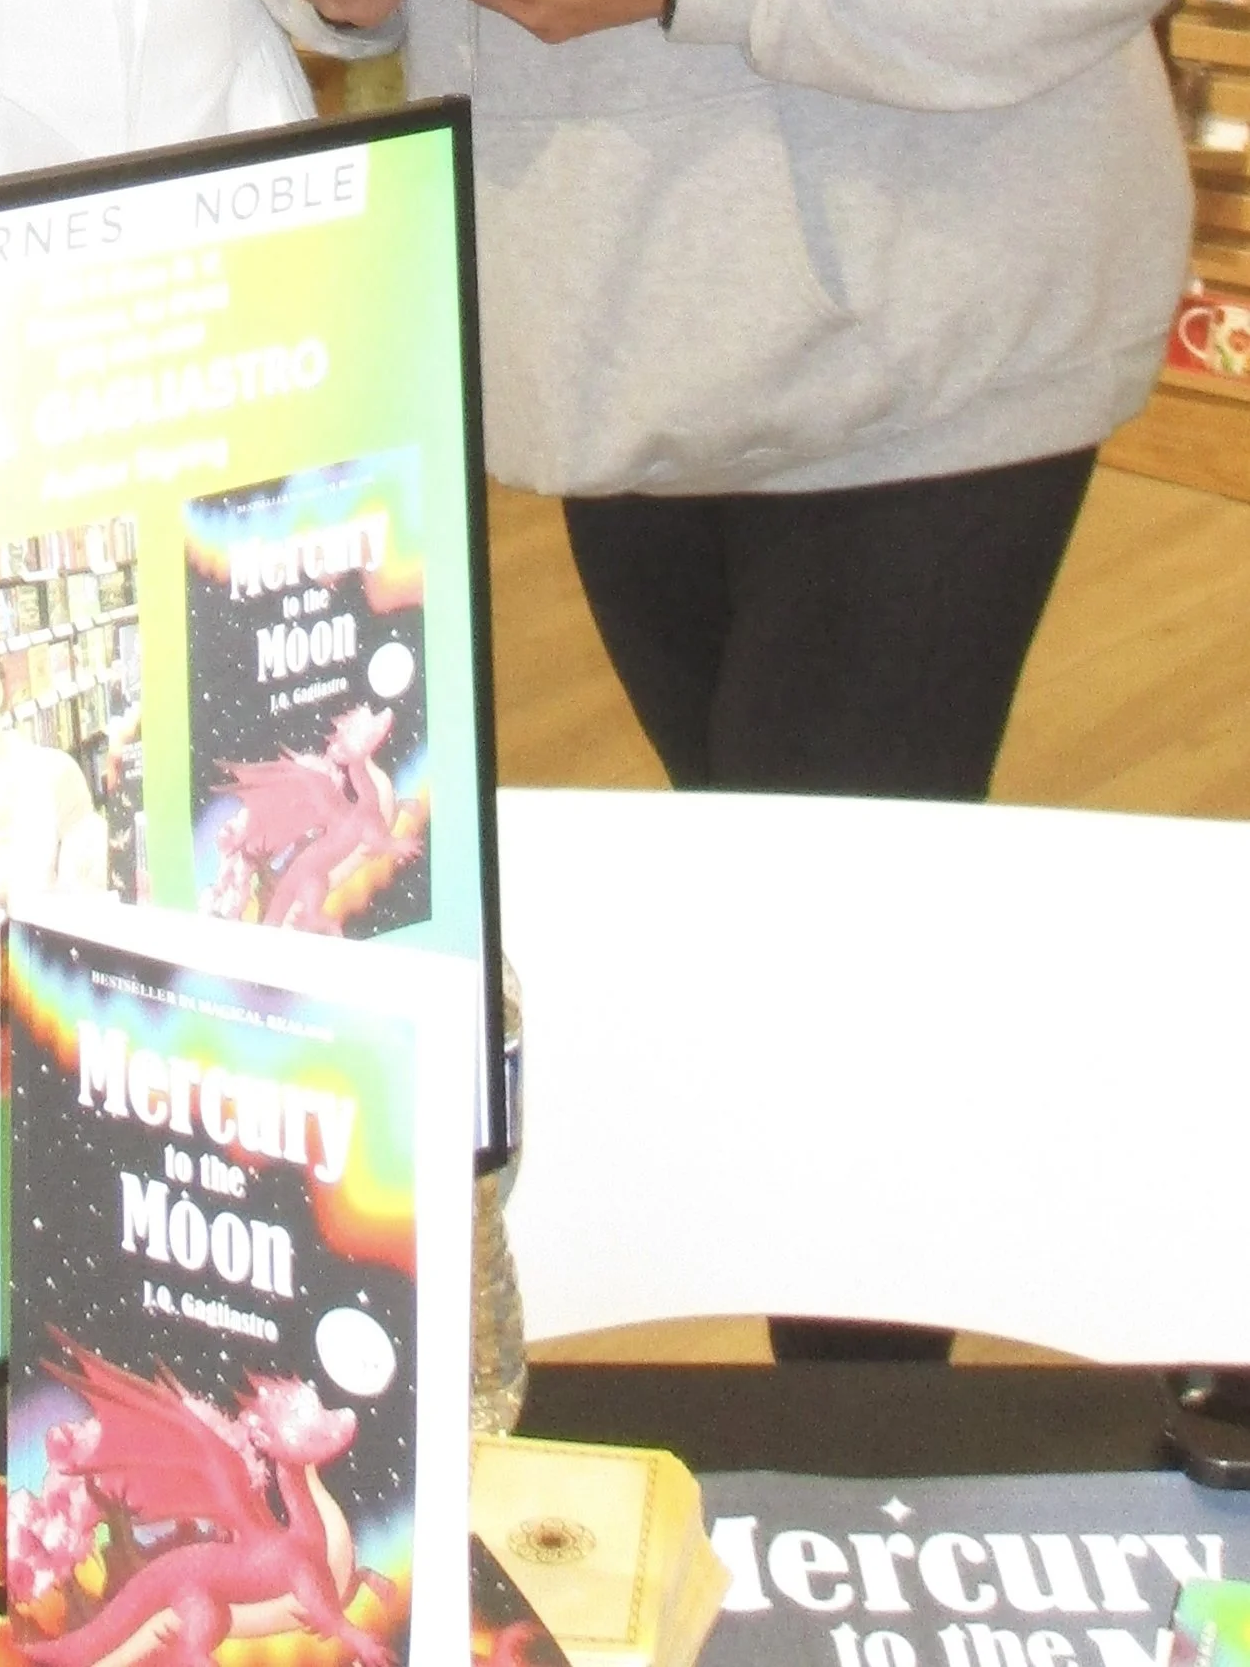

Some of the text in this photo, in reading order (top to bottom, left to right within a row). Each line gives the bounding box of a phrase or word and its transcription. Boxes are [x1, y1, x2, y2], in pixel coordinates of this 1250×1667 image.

[193, 163, 355, 228] NOBLE
[228, 511, 389, 600] Mercury
[282, 588, 331, 619] to the
[256, 613, 357, 682] Moon
[90, 969, 178, 1006] BESTSELLER
[76, 1019, 356, 1183] Mercury
[164, 1143, 247, 1198] to the
[119, 1171, 296, 1299] Moon
[181, 1292, 280, 1344] Gagliastro
[830, 1621, 918, 1667] to
[938, 1622, 1077, 1667] the
